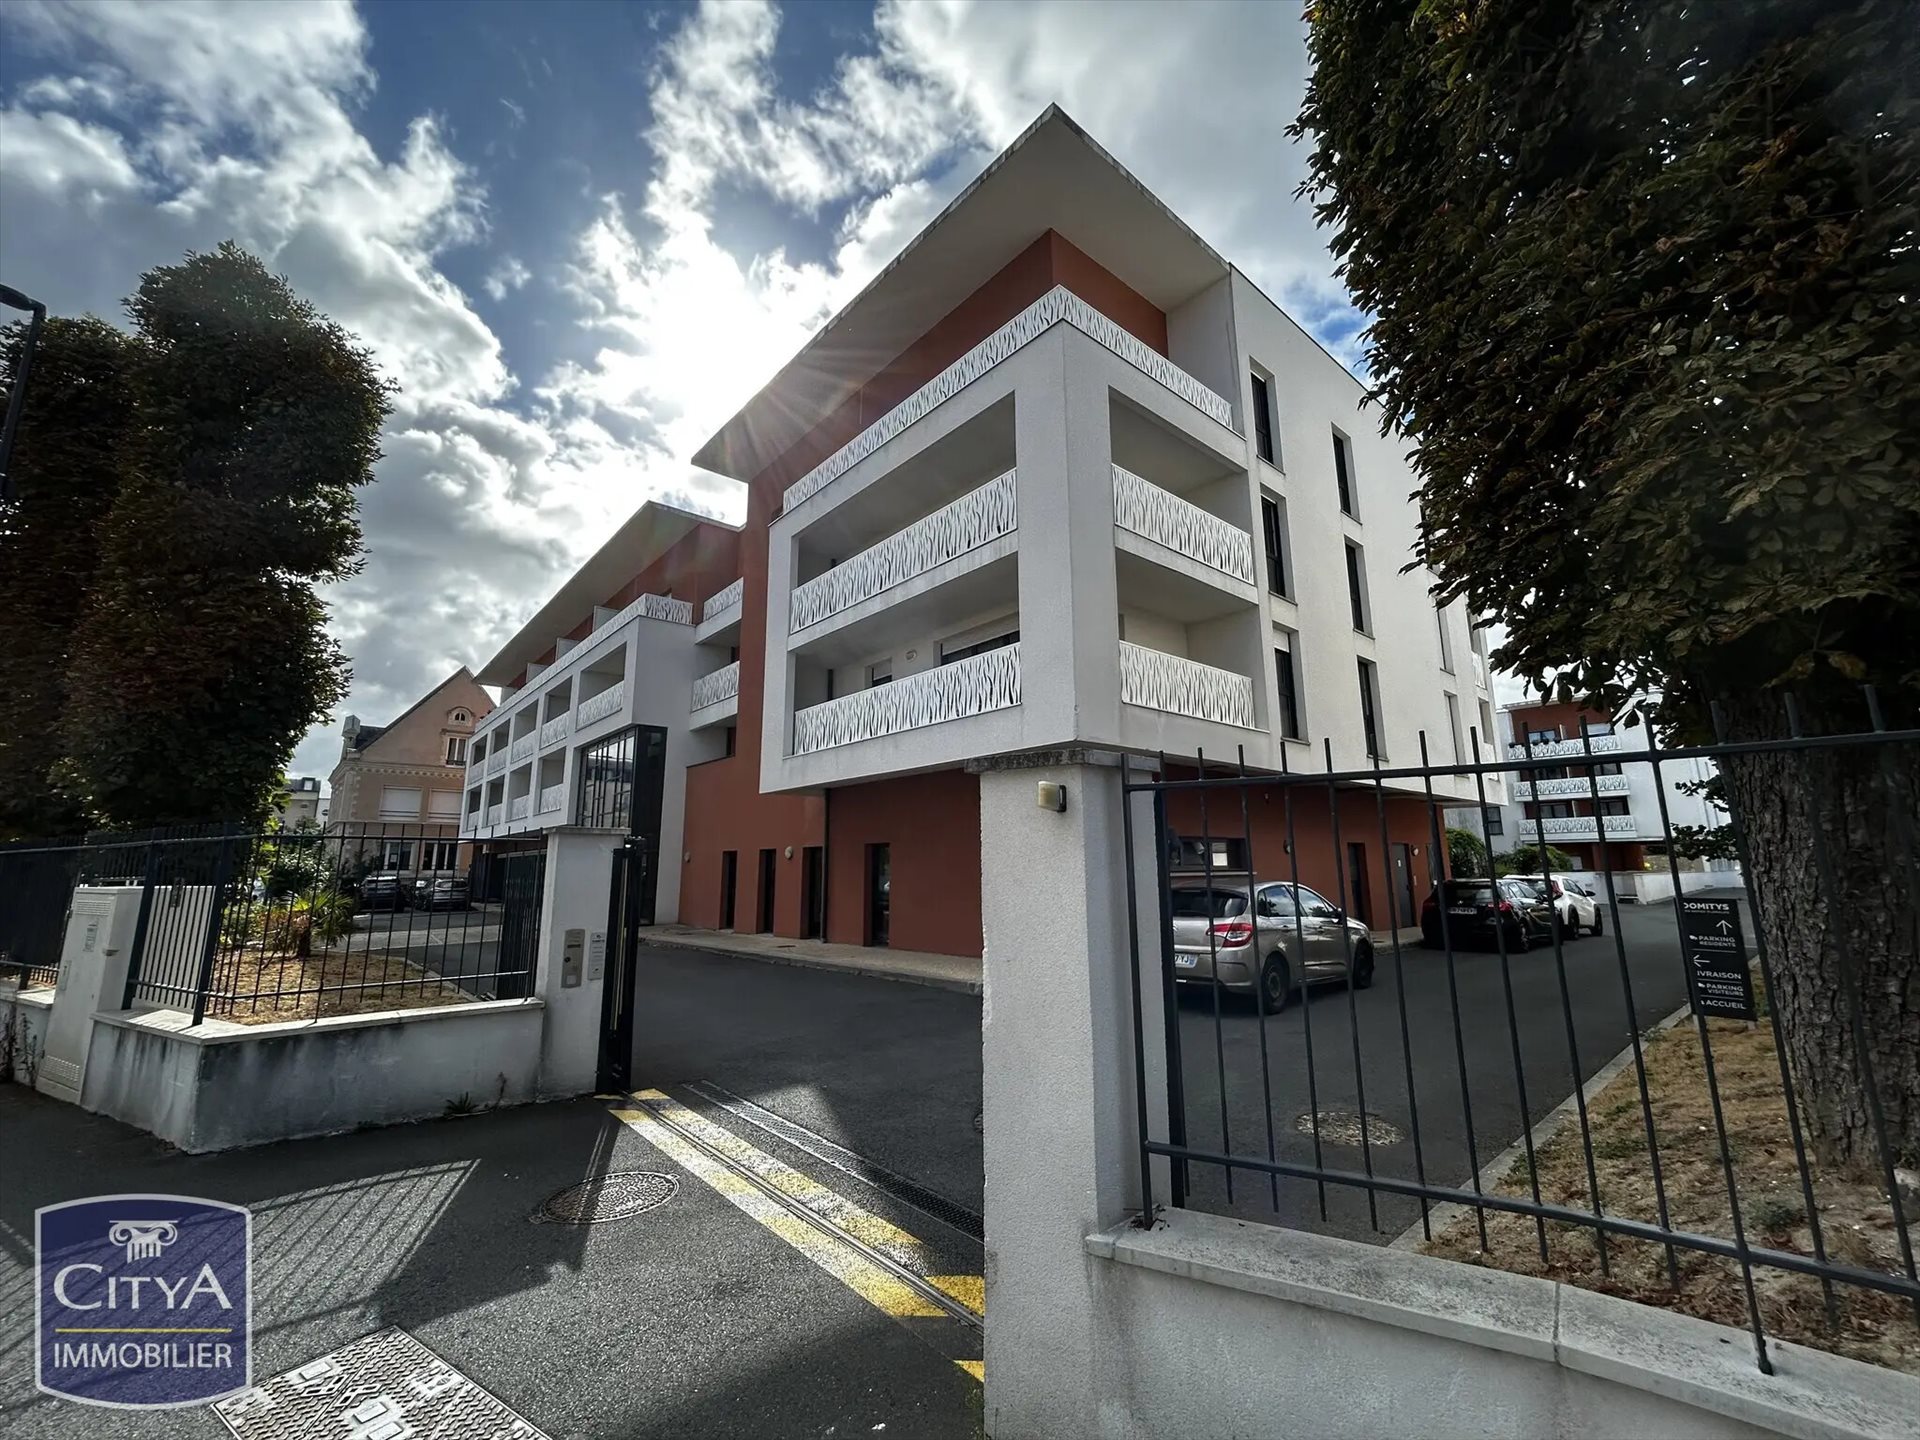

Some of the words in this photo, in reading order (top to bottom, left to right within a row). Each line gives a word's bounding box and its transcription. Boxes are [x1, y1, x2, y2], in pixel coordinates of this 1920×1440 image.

[1698, 935, 1736, 943] PARKING
[1696, 970, 1742, 980] IVRAISON
[1706, 983, 1744, 992] PARKING
[1707, 988, 1745, 996] VISITEURS
[1705, 999, 1747, 1010] ACCUEIL
